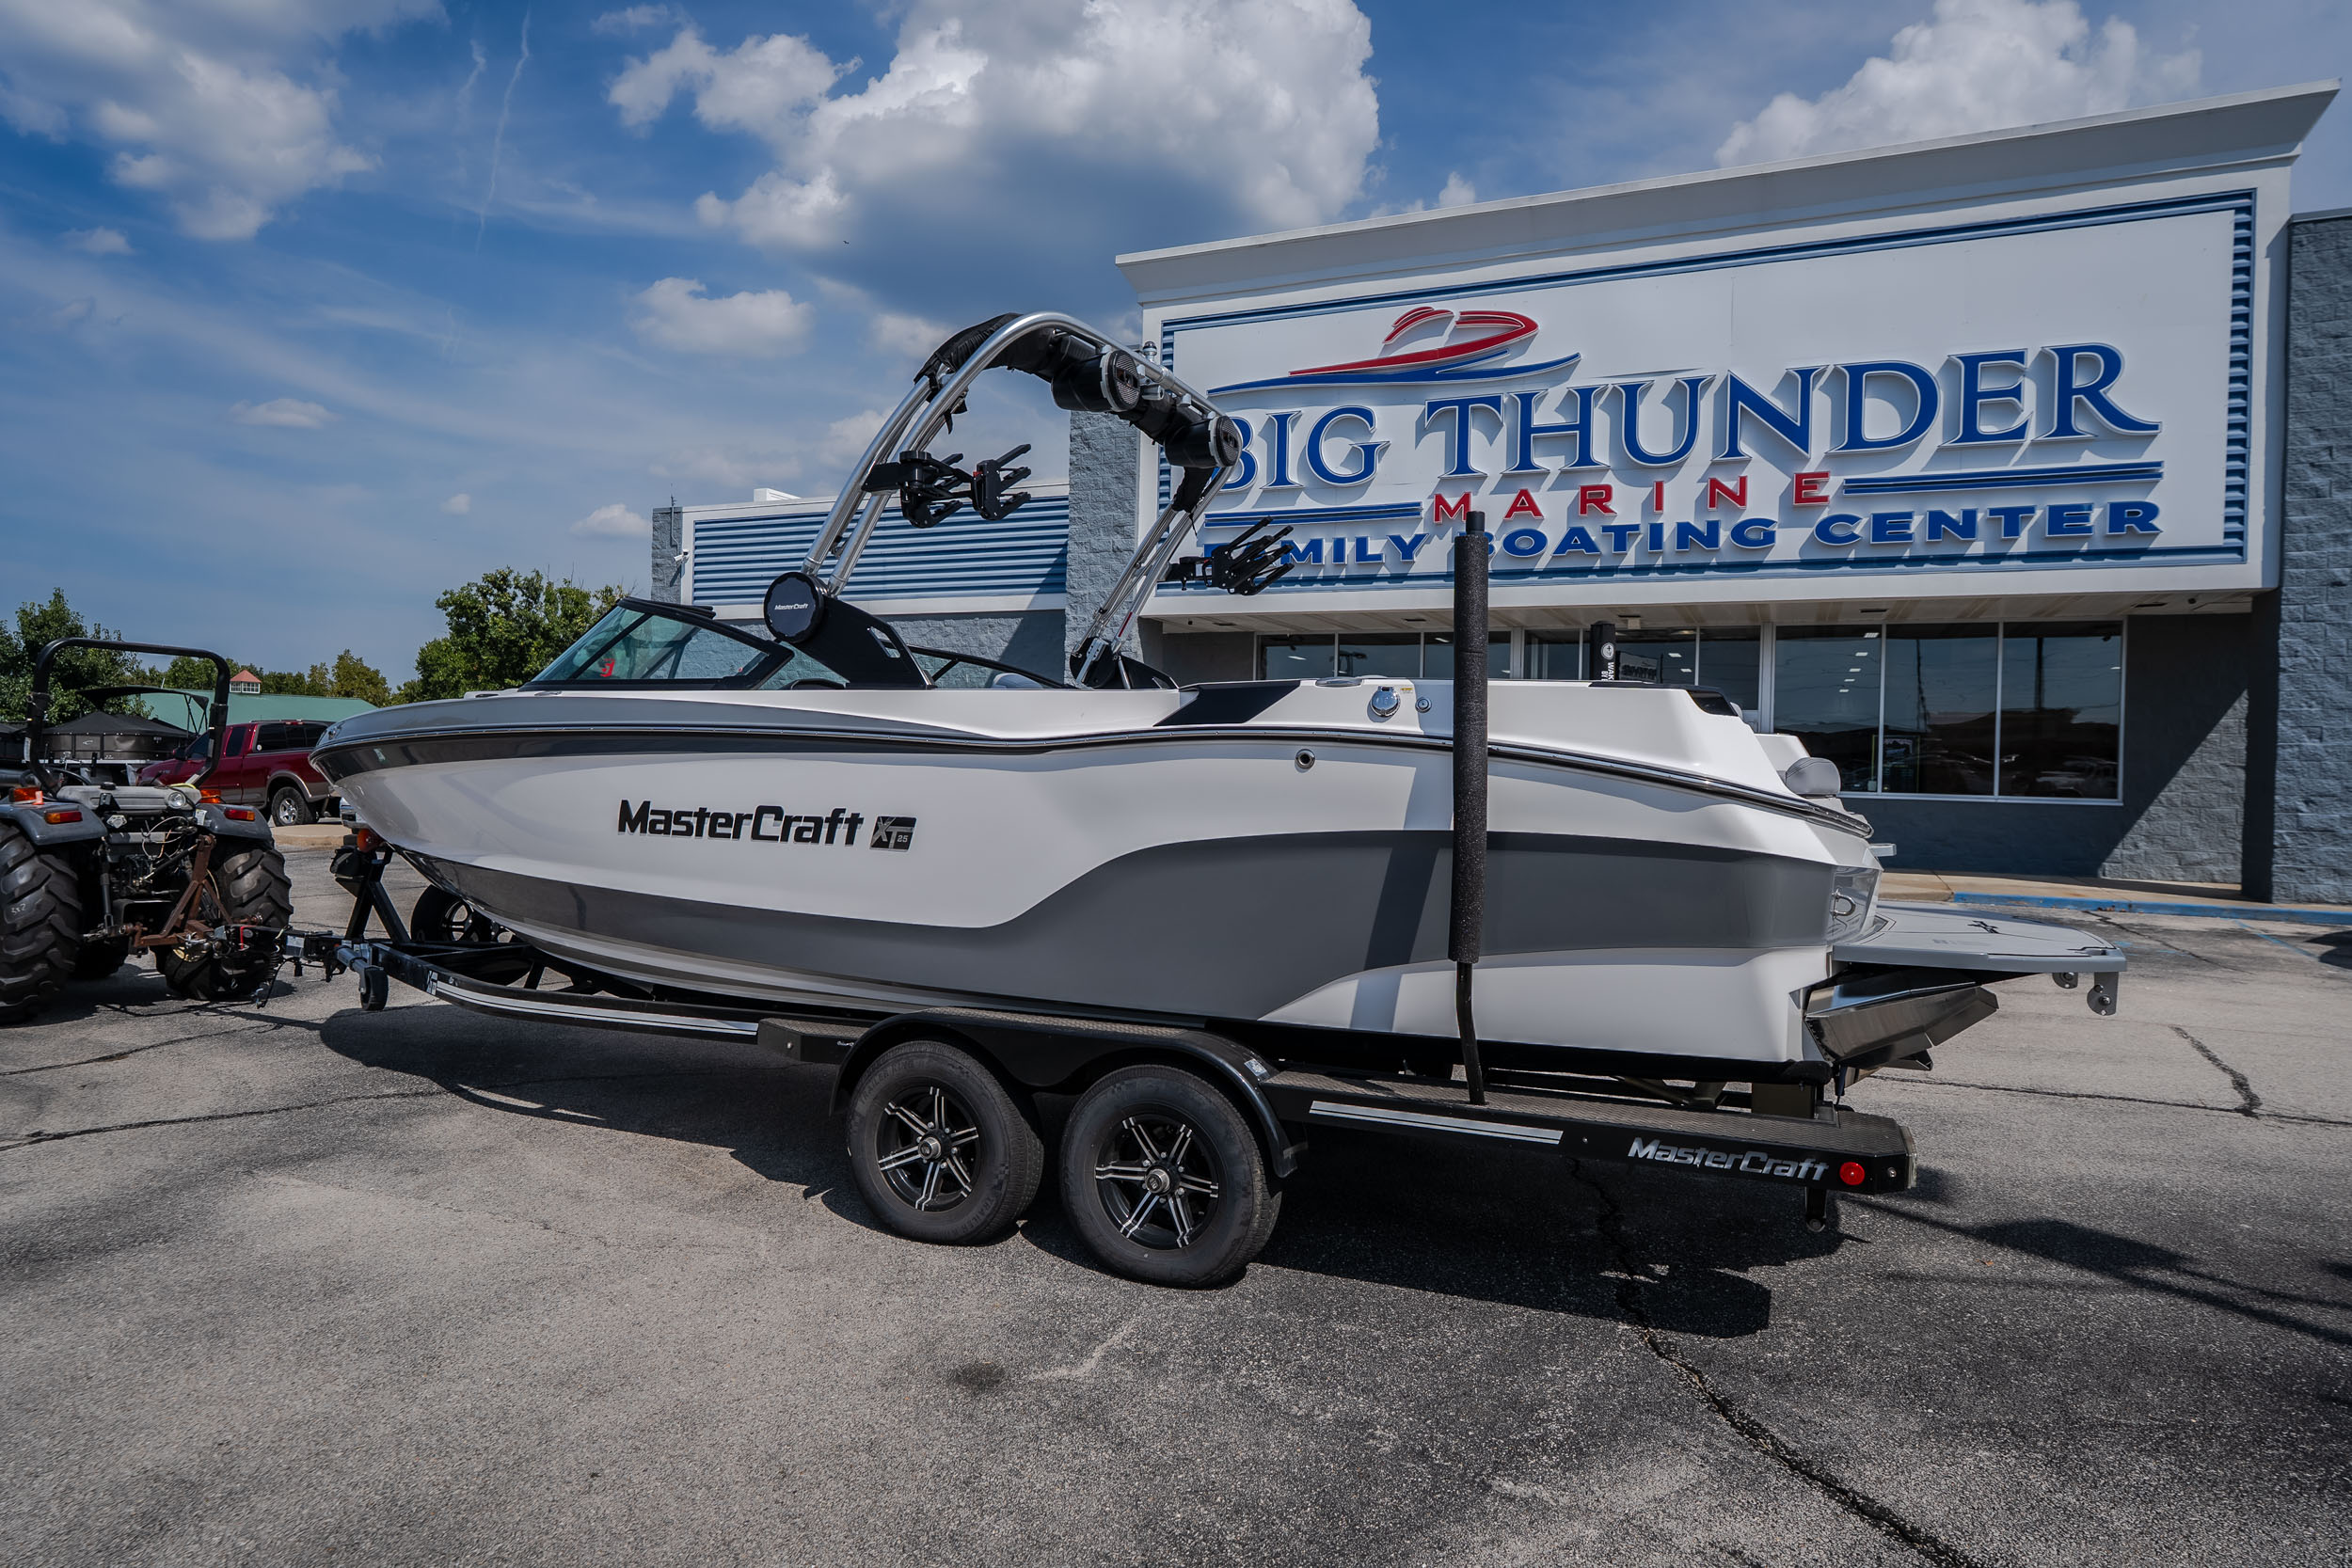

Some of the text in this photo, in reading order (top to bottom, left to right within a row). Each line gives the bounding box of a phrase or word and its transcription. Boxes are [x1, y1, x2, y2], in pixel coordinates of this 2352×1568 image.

[1424, 342, 2162, 479] THUNDER
[1434, 471, 1831, 523] MARINE
[1204, 532, 1430, 566] MILY
[1814, 500, 2162, 546] CENTER
[618, 799, 864, 846] MasterCraft
[1628, 1136, 1829, 1180] MasterCraft
